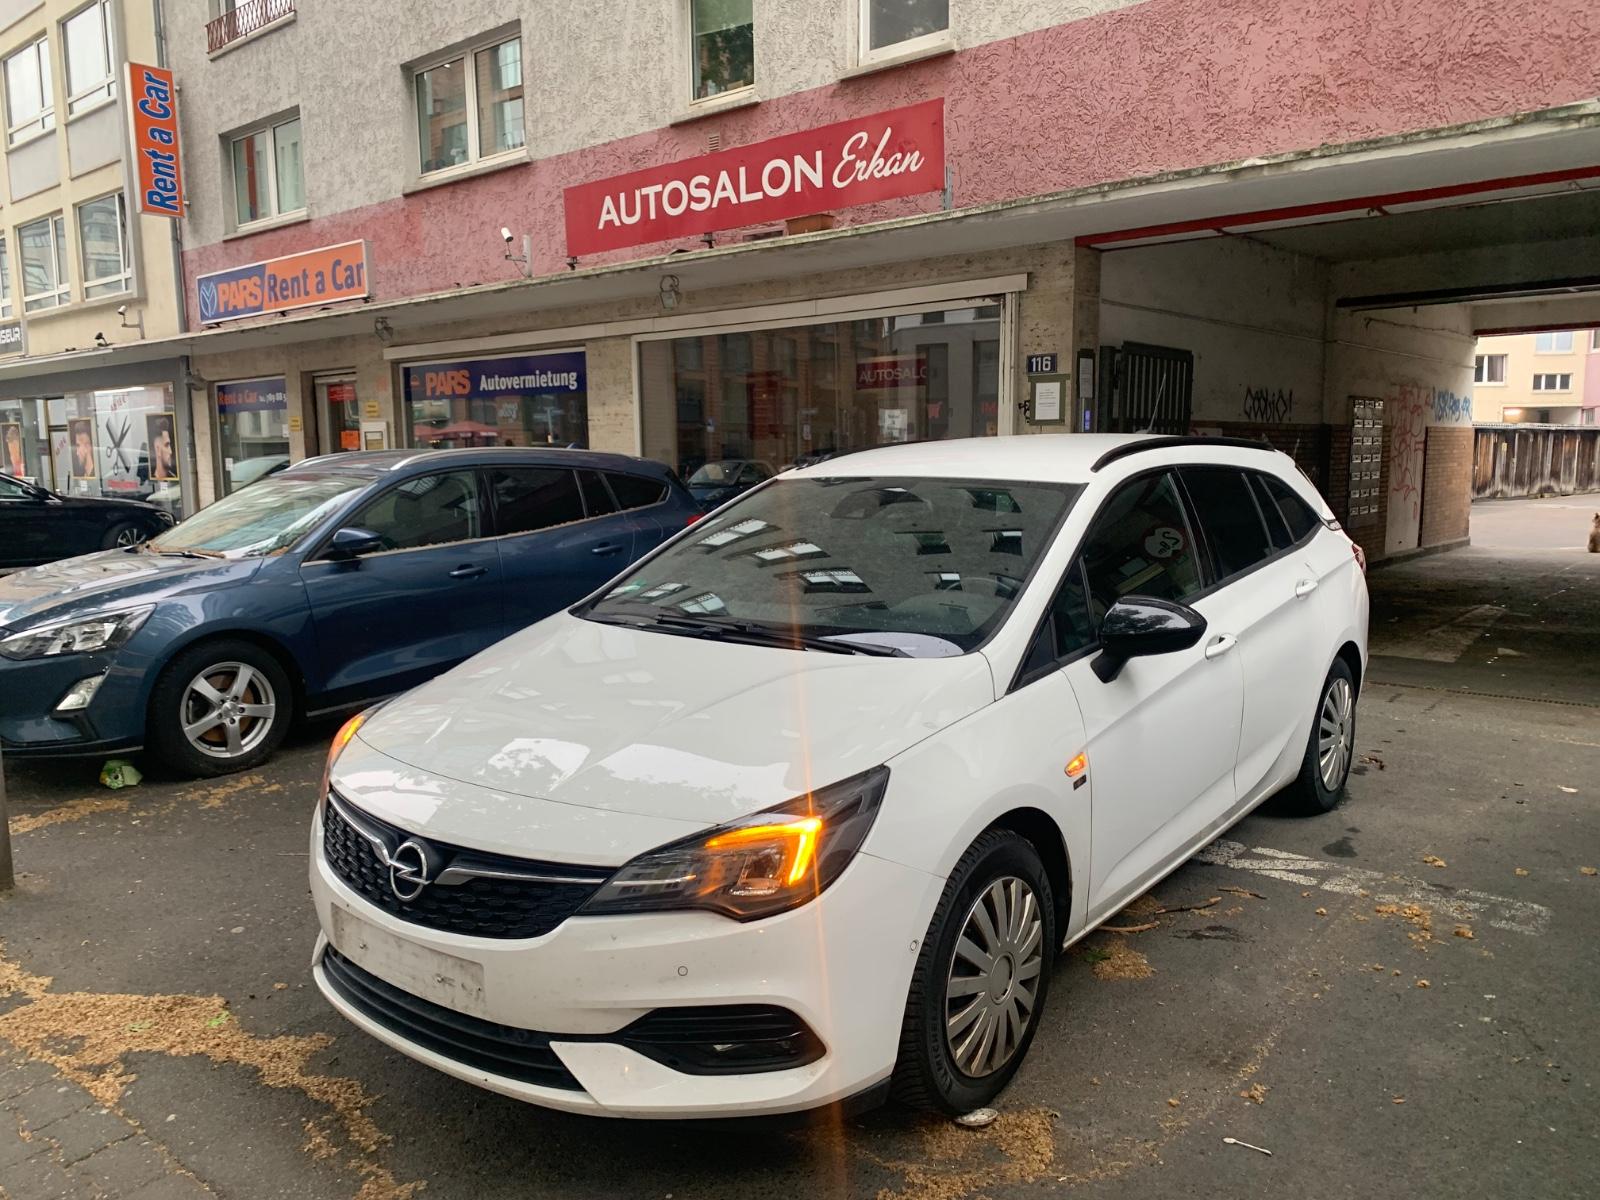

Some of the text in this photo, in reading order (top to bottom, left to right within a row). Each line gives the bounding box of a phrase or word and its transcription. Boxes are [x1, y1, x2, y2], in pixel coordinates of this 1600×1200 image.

[138, 71, 180, 211] Rent a Car
[598, 127, 924, 229] AUTOSALON Erkan
[217, 258, 364, 312] PARS Rent a Car
[425, 369, 577, 396] PARS Autovermietung
[1031, 356, 1051, 372] 116
